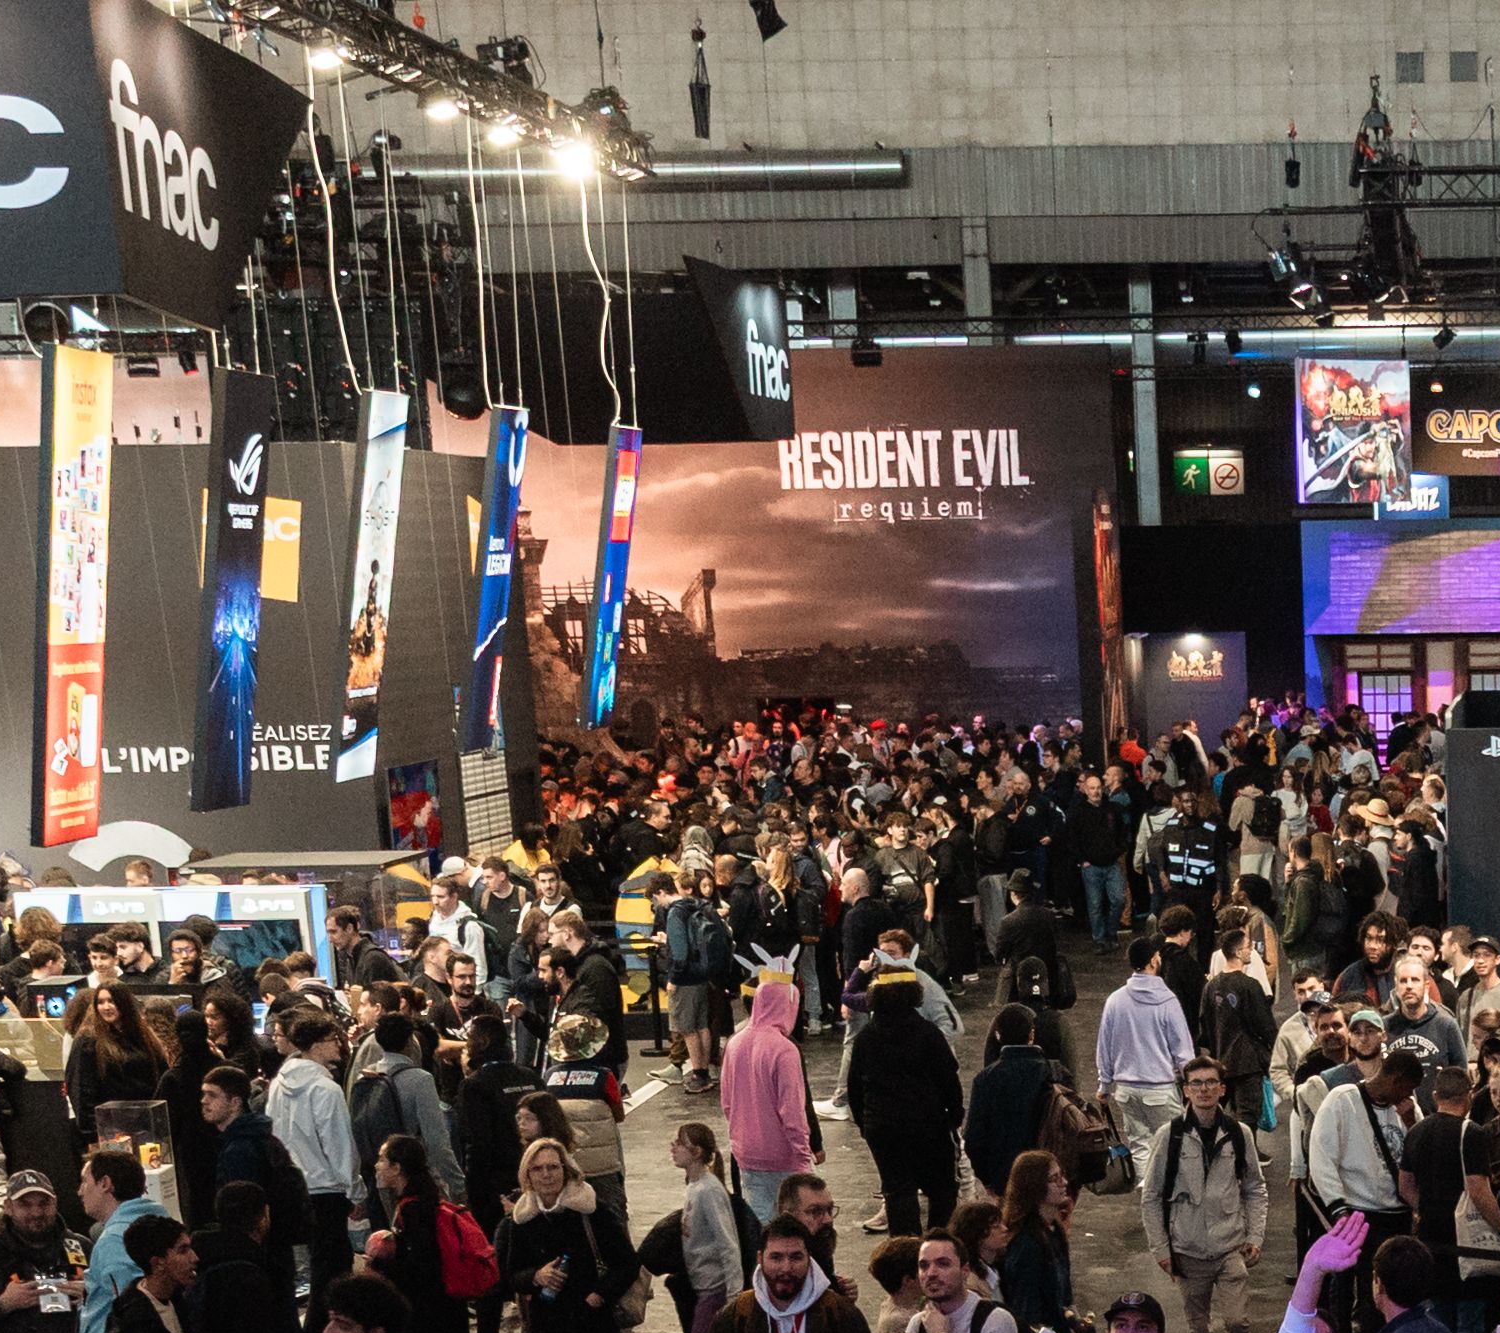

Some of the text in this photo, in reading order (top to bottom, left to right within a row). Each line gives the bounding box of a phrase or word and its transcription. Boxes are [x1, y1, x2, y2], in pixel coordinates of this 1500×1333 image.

[109, 58, 220, 251] fnac
[746, 319, 791, 402] fnac
[1330, 407, 1382, 417] ONIMUSHA
[778, 428, 1032, 490] RESIDENT EVIL
[839, 499, 975, 524] requiem
[251, 722, 332, 742] ÉALISEZ
[102, 744, 330, 774] L'IMPSIBLE
[109, 900, 146, 914] PS5
[258, 898, 295, 912] PS5
